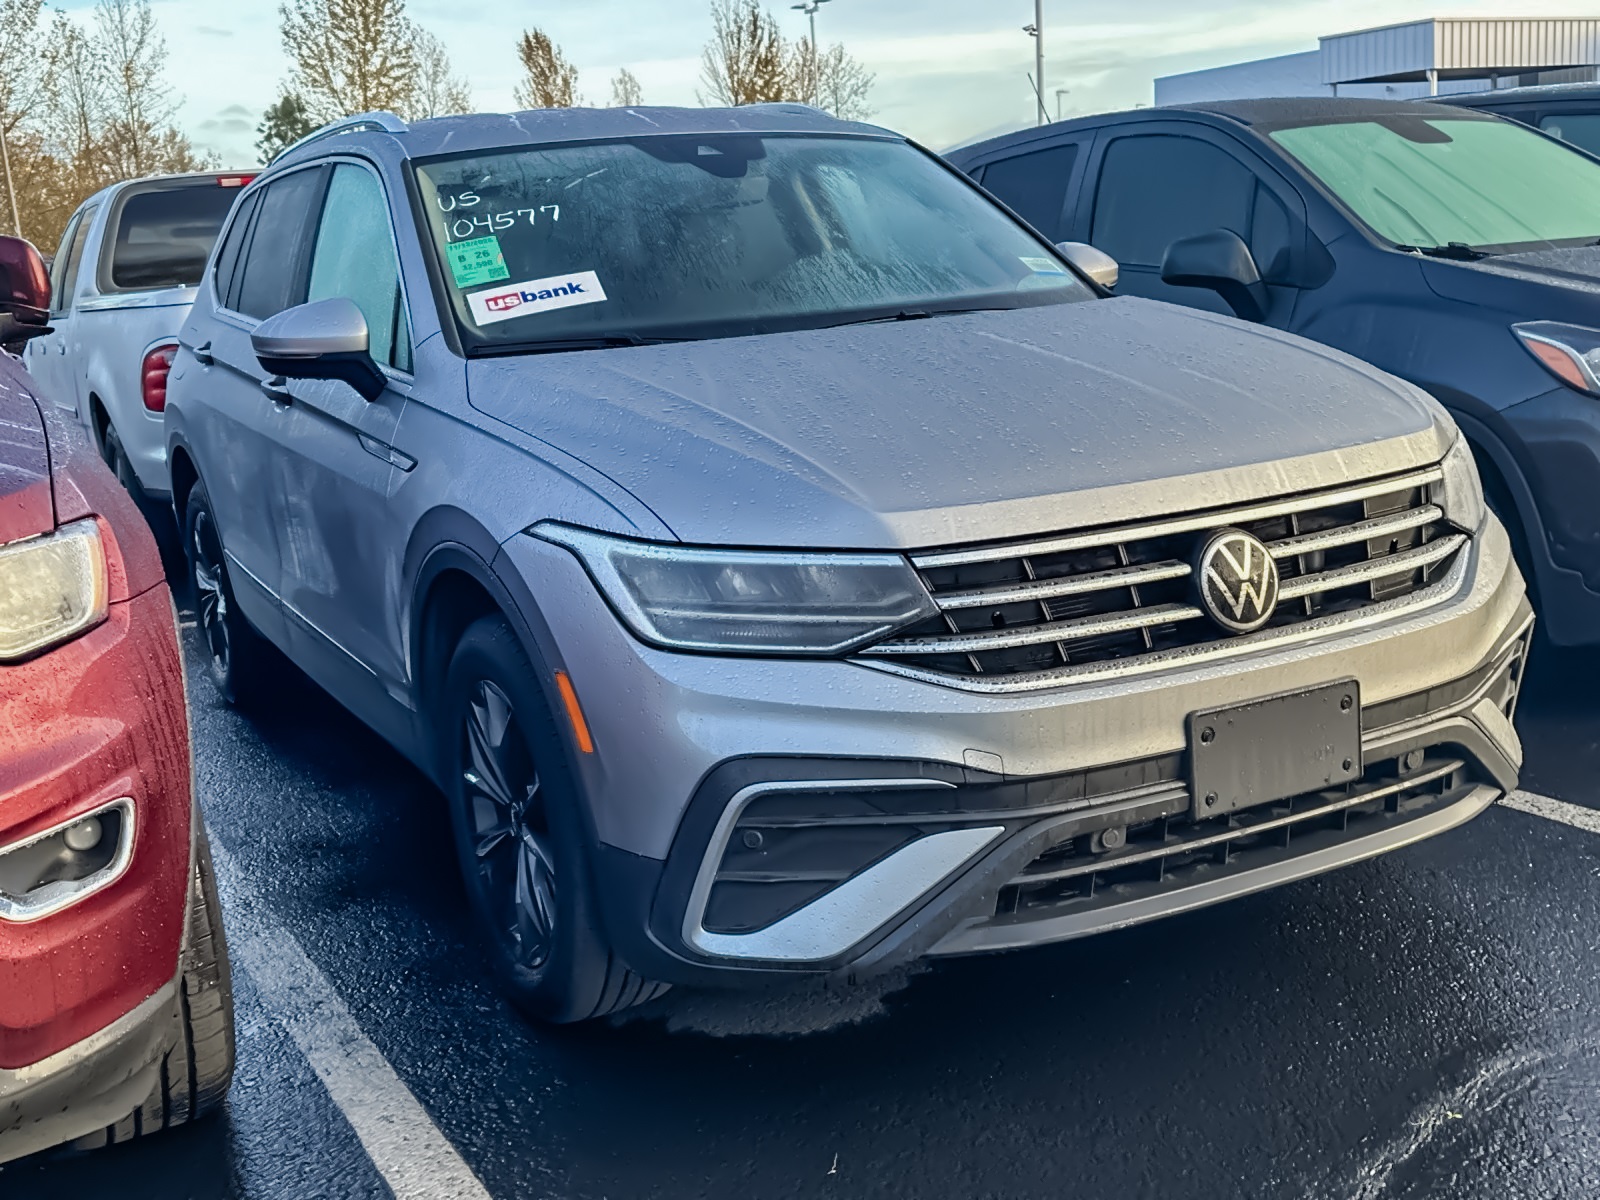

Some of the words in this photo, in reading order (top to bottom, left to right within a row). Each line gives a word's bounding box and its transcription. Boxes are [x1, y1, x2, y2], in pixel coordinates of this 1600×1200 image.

[438, 191, 480, 211] US
[443, 205, 559, 242] 104577
[474, 250, 490, 259] 26
